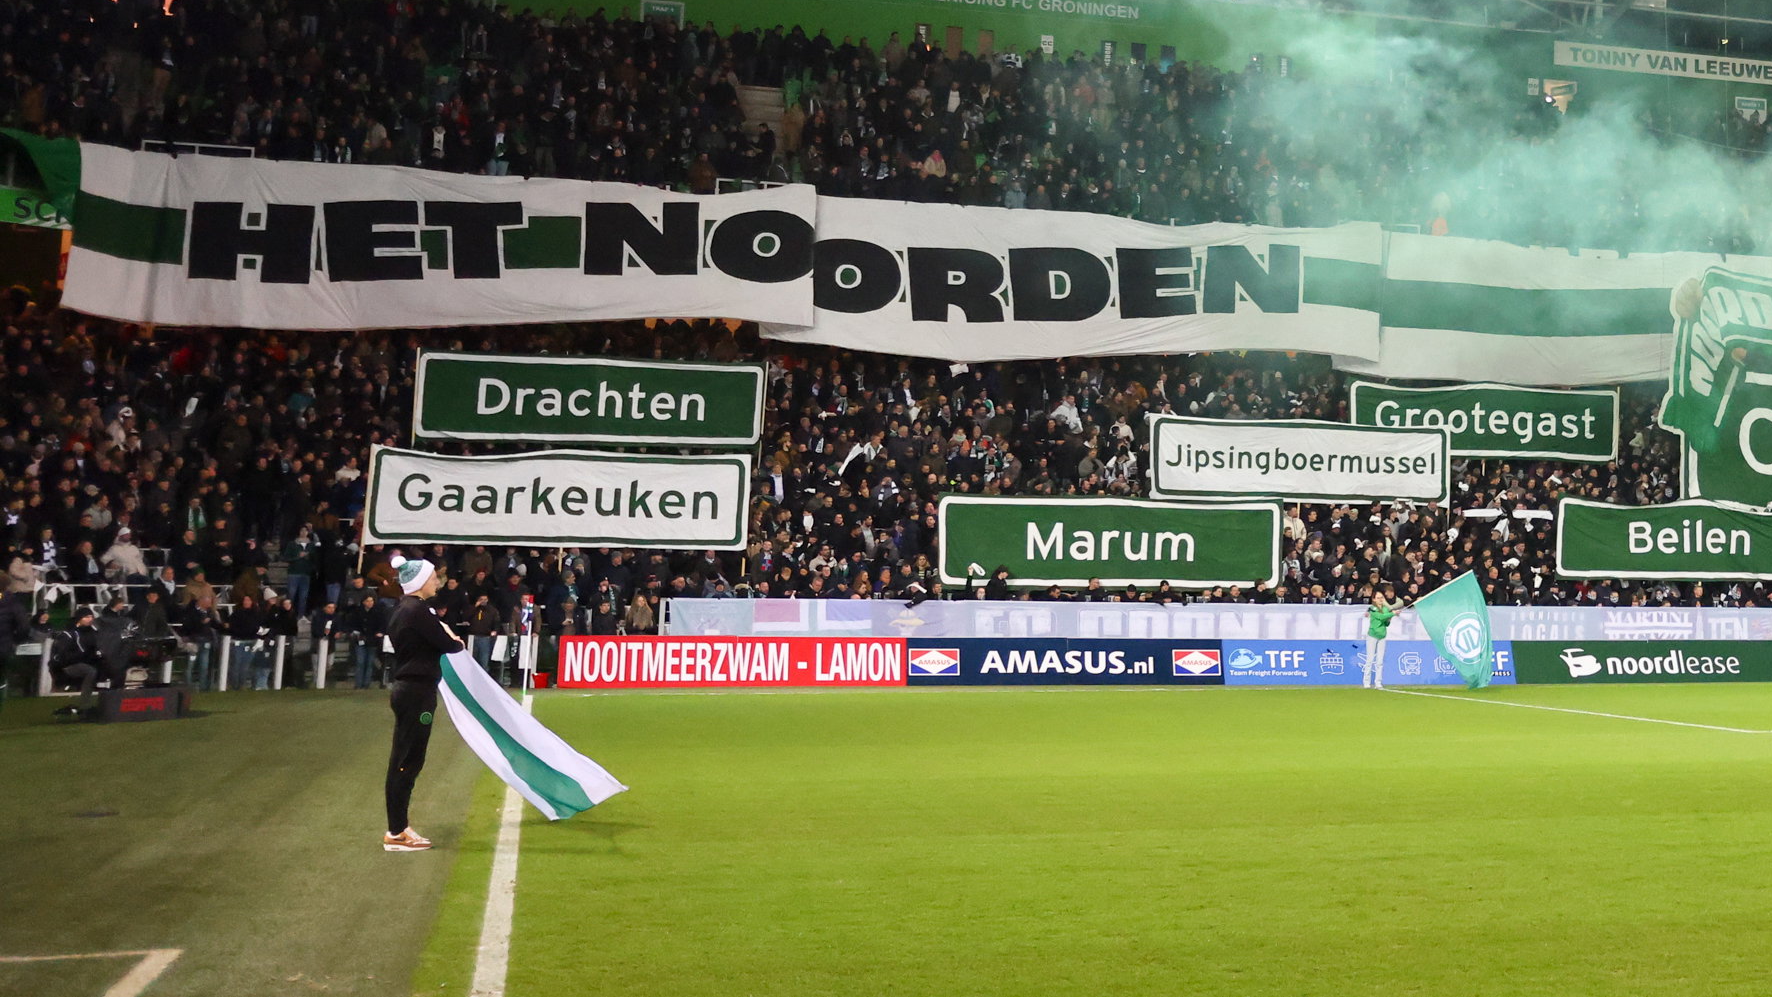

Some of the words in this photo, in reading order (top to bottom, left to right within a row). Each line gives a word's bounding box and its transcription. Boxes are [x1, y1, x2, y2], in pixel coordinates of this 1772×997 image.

[1569, 46, 1640, 70] TONNY
[1646, 53, 1689, 72] VAN
[188, 201, 523, 284] HET
[584, 201, 1300, 322] NOORDEN
[475, 377, 706, 422] Drachten
[1375, 400, 1596, 444] Grootegast
[1166, 442, 1437, 476] Jipsingboermussel
[398, 473, 719, 520] Gaarkeuken
[1025, 522, 1196, 562] Marum
[1628, 518, 1751, 558] Beilen
[1606, 610, 1690, 624] MARTINI
[564, 641, 789, 683] NOOITMEERZWAM
[816, 642, 901, 682] LAMON
[917, 659, 951, 667] AMASUS
[980, 649, 1154, 675] AMASUS.nl
[1181, 659, 1213, 667] AMASUS
[1265, 650, 1305, 669] TFF
[1607, 649, 1740, 676] noordlease
